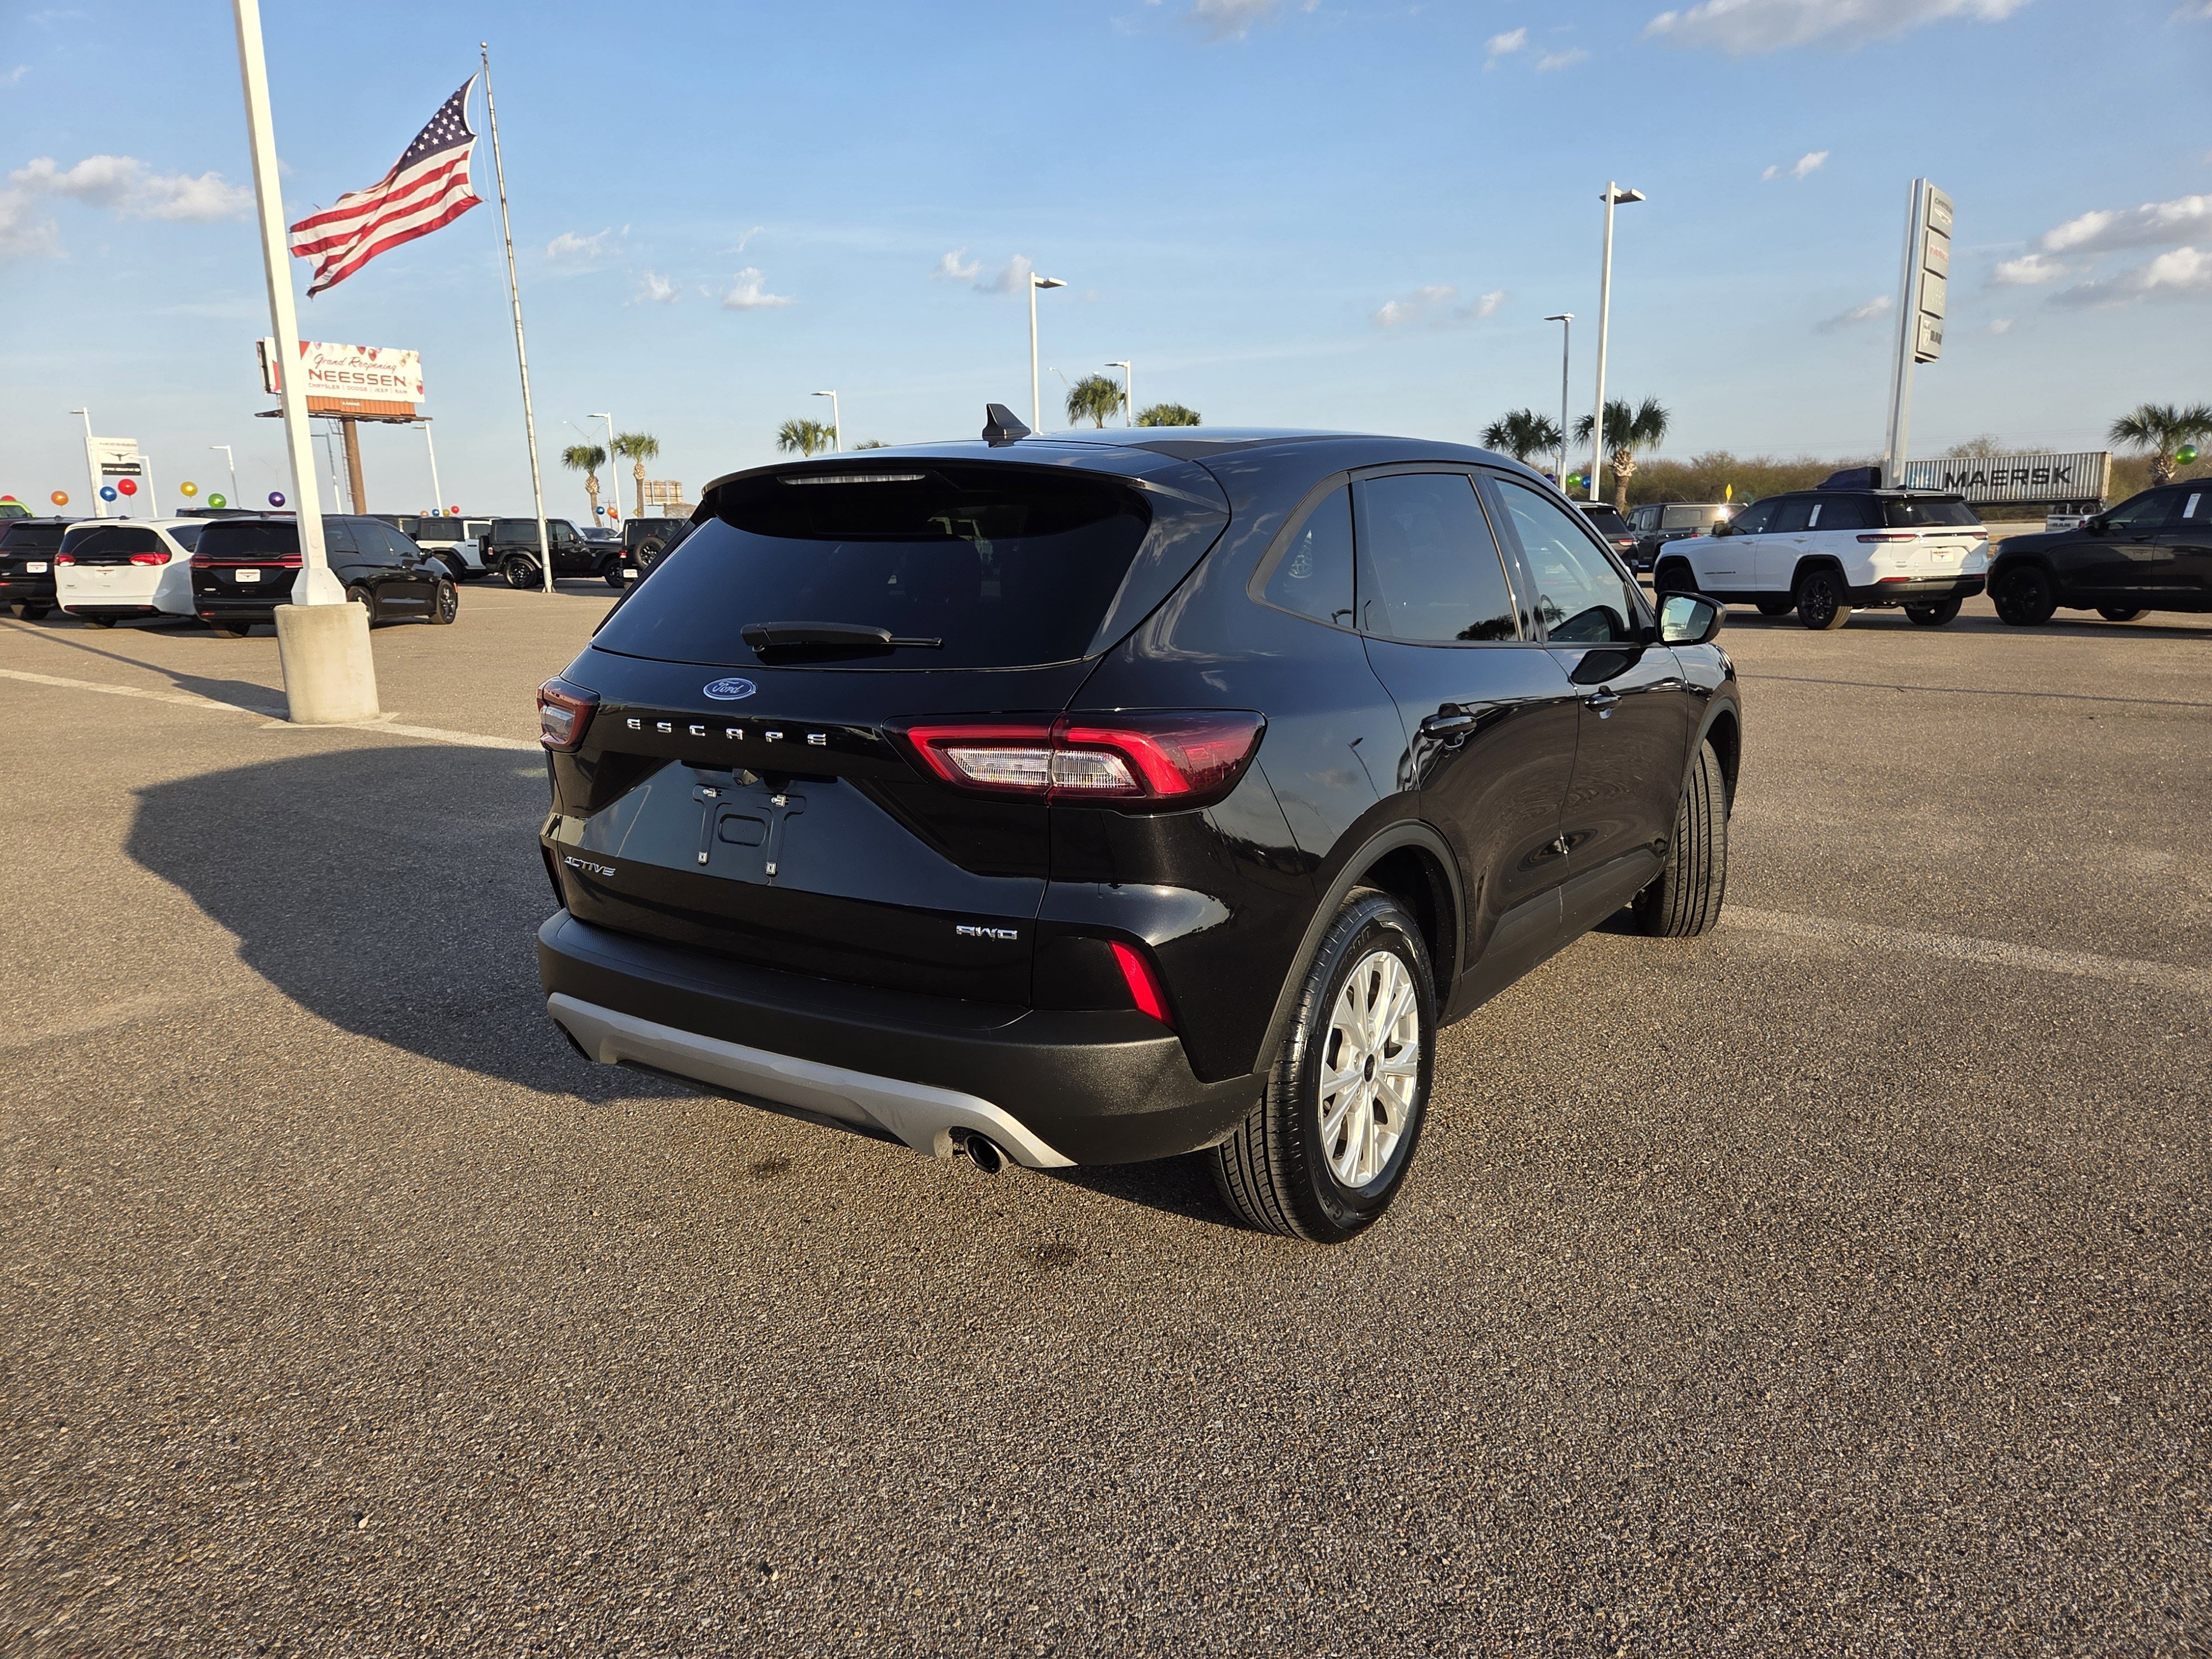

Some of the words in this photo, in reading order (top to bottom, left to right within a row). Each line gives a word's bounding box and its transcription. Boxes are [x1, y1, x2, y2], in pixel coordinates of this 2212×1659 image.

[314, 353, 347, 369] Grand
[308, 369, 407, 387] NEESSEN
[1944, 466, 2072, 488] MAERSK
[712, 680, 744, 694] Ford
[627, 718, 827, 746] ESCAPE
[564, 856, 616, 877] ACTIVE
[956, 925, 1018, 940] AWD
